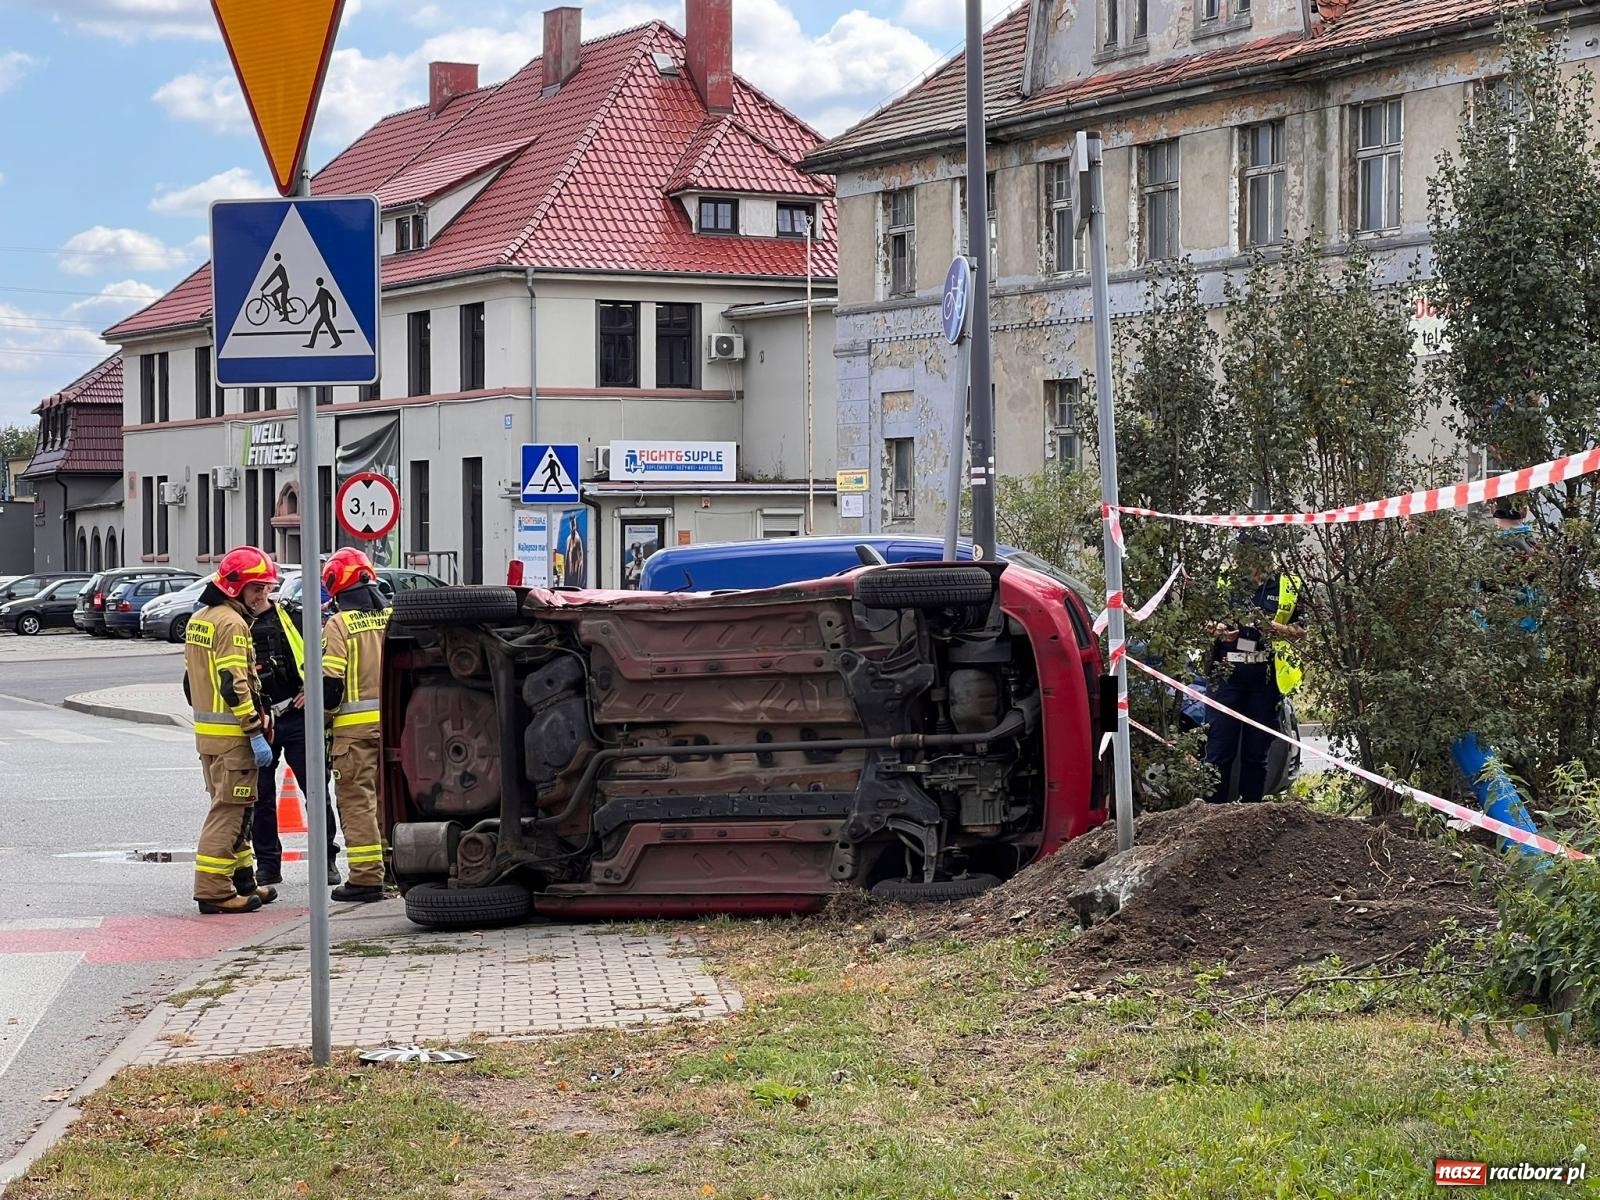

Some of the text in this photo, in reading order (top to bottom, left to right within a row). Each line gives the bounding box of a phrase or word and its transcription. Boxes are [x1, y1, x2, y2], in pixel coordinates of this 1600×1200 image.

[251, 423, 285, 443] WELL
[248, 443, 298, 466] FITNESS
[639, 450, 723, 462] FIGHT&SUPLE
[349, 497, 388, 517] 3,1m
[235, 787, 249, 795] PSP
